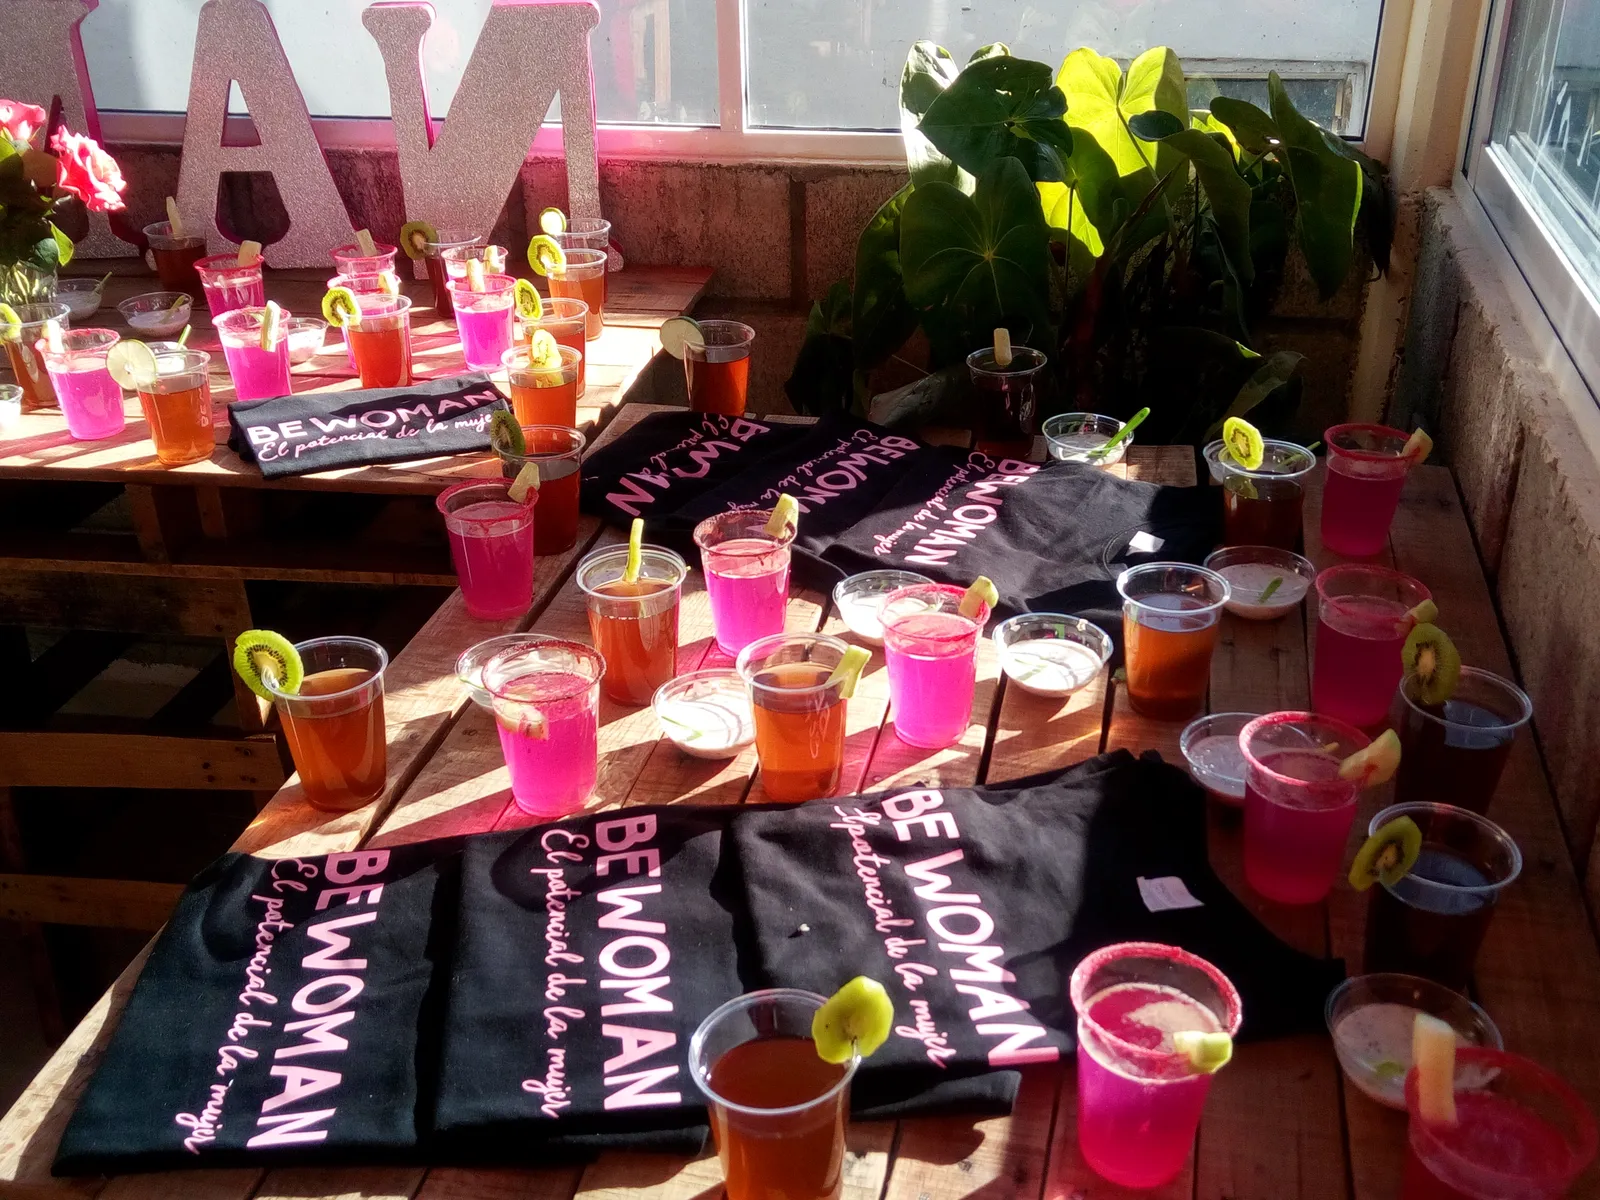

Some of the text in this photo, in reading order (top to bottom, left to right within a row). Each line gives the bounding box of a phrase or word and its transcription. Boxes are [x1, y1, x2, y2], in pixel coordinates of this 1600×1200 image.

[247, 390, 498, 445] BE WOMAN
[258, 414, 493, 462] El potencial de la muje
[852, 429, 878, 443] El
[778, 475, 801, 487] de
[926, 464, 970, 511] potencial
[967, 452, 995, 473] El
[904, 481, 1020, 565] WOMAN
[914, 508, 940, 522] de
[874, 530, 903, 556] mujer
[830, 822, 914, 932] potencial
[881, 790, 1060, 1066] BE WOMAN
[884, 937, 926, 958] de
[522, 829, 589, 1119] El potencial de la mujer
[596, 814, 682, 1110] BE WOMAN
[894, 962, 938, 991] la
[176, 859, 318, 1155] El potencial de la mujer
[246, 850, 390, 1148] BE WOMAN
[895, 1000, 956, 1069] mujer
